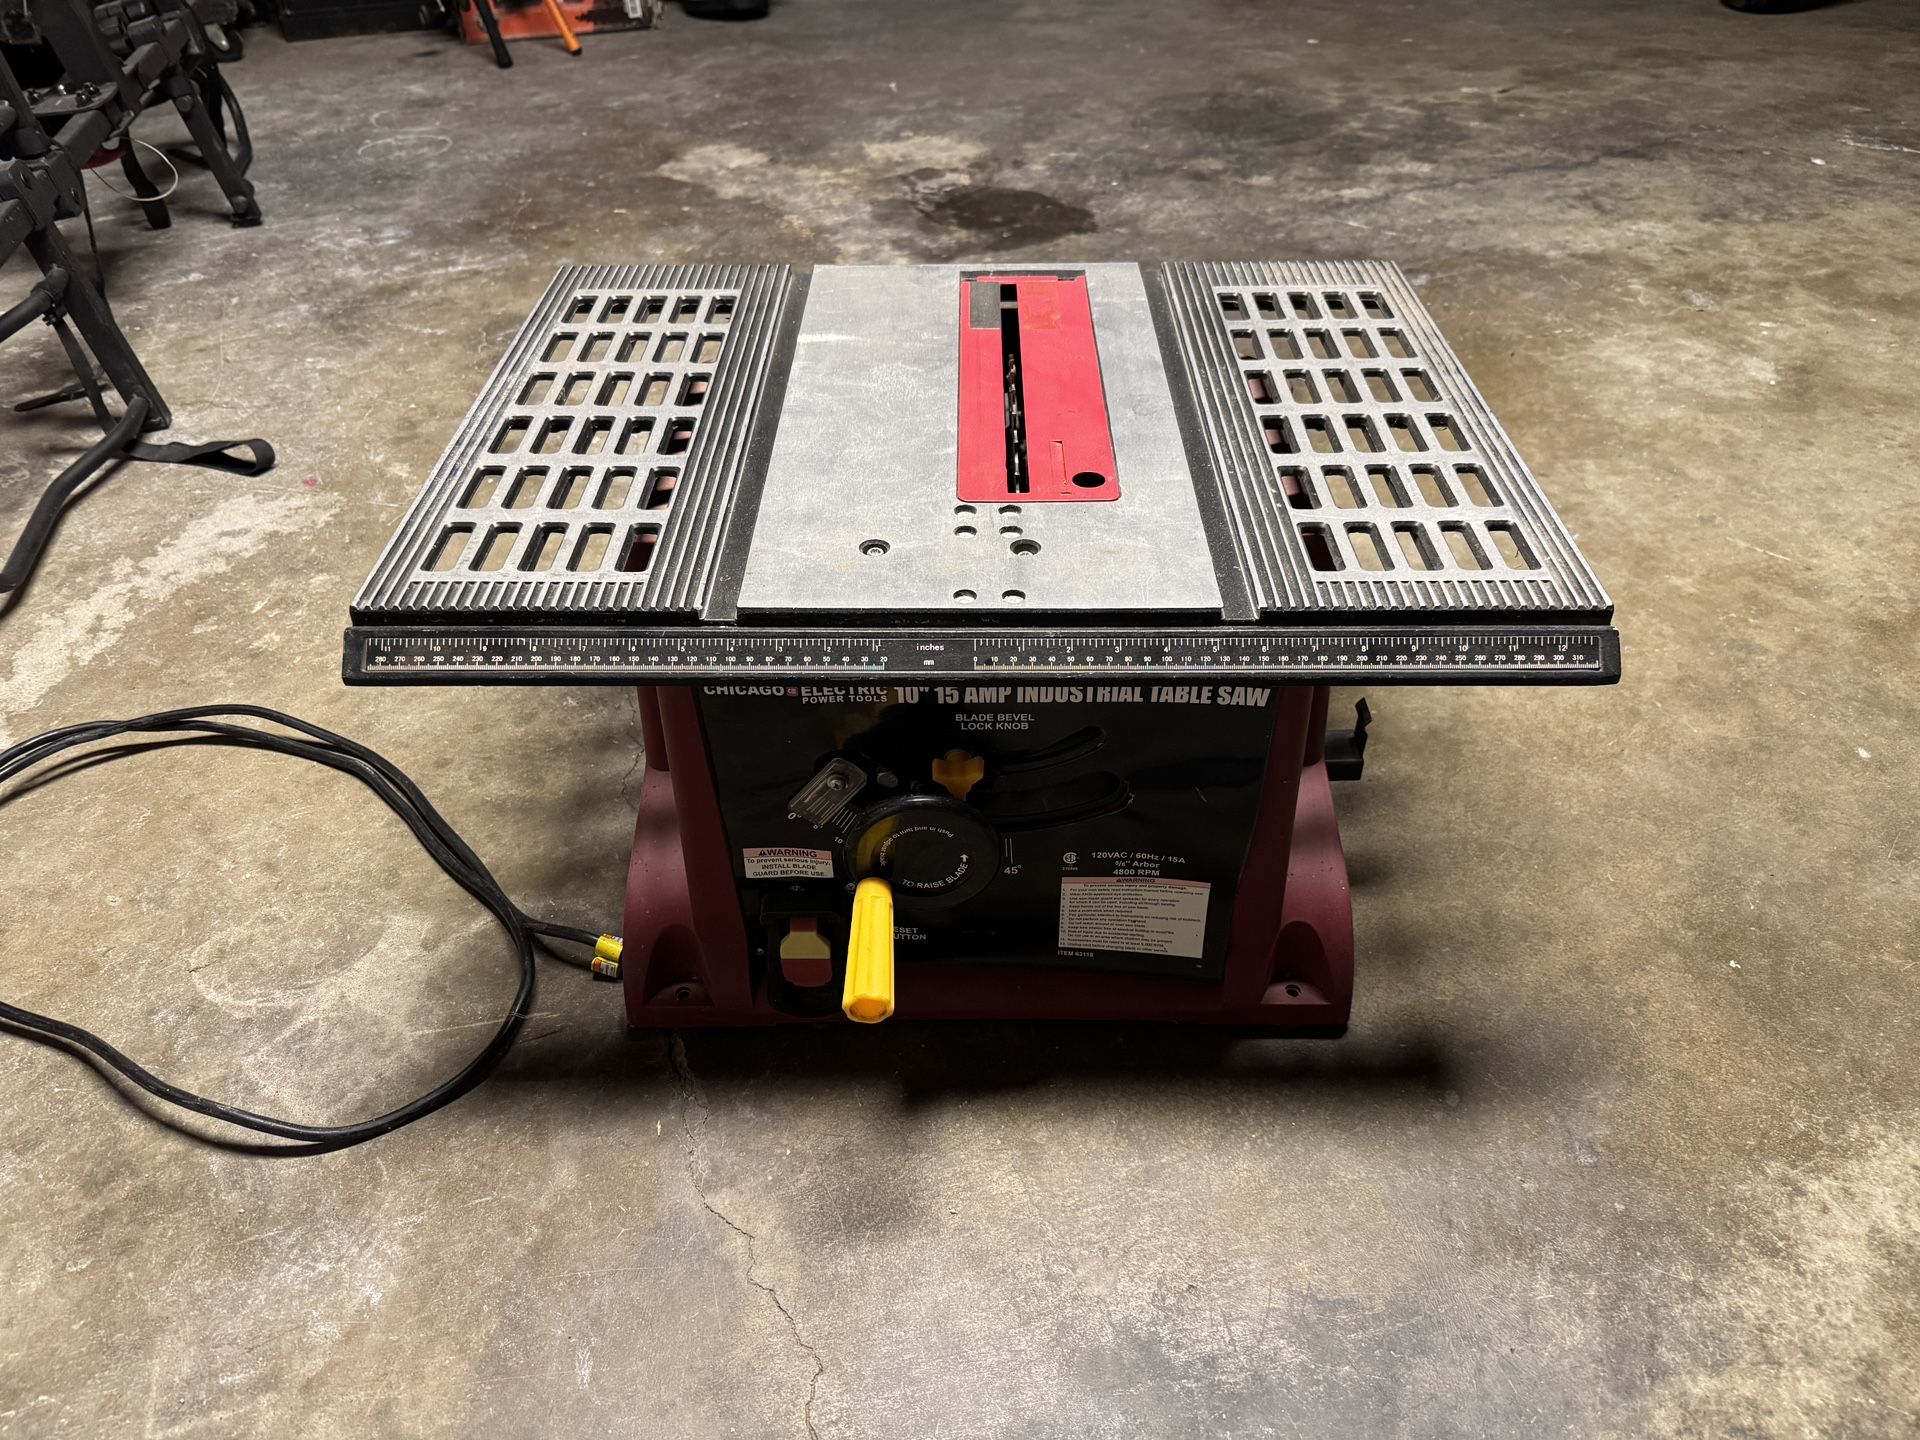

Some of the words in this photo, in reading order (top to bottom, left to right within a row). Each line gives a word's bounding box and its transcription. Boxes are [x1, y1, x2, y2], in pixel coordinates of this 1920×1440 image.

[916, 643, 946, 651] inches
[704, 686, 785, 696] CHICAGO
[802, 686, 888, 696] ELECTRIC
[934, 686, 960, 704] 15
[964, 686, 1012, 704] AMP
[1016, 686, 1143, 704] INDUSTRIAL
[1149, 686, 1212, 704] TABLE
[1216, 686, 1270, 707] SAW
[961, 722, 993, 730] LOCK
[996, 722, 1029, 730] KNOB
[900, 828, 914, 836] turn
[937, 828, 954, 838] Push
[766, 849, 817, 857] WARNING
[1135, 853, 1159, 861] 60Hz
[1167, 856, 1186, 864] 15A
[1004, 864, 1022, 874] 45°
[902, 878, 914, 887] TO
[916, 880, 946, 888] RAISE
[945, 862, 968, 884] BLADE
